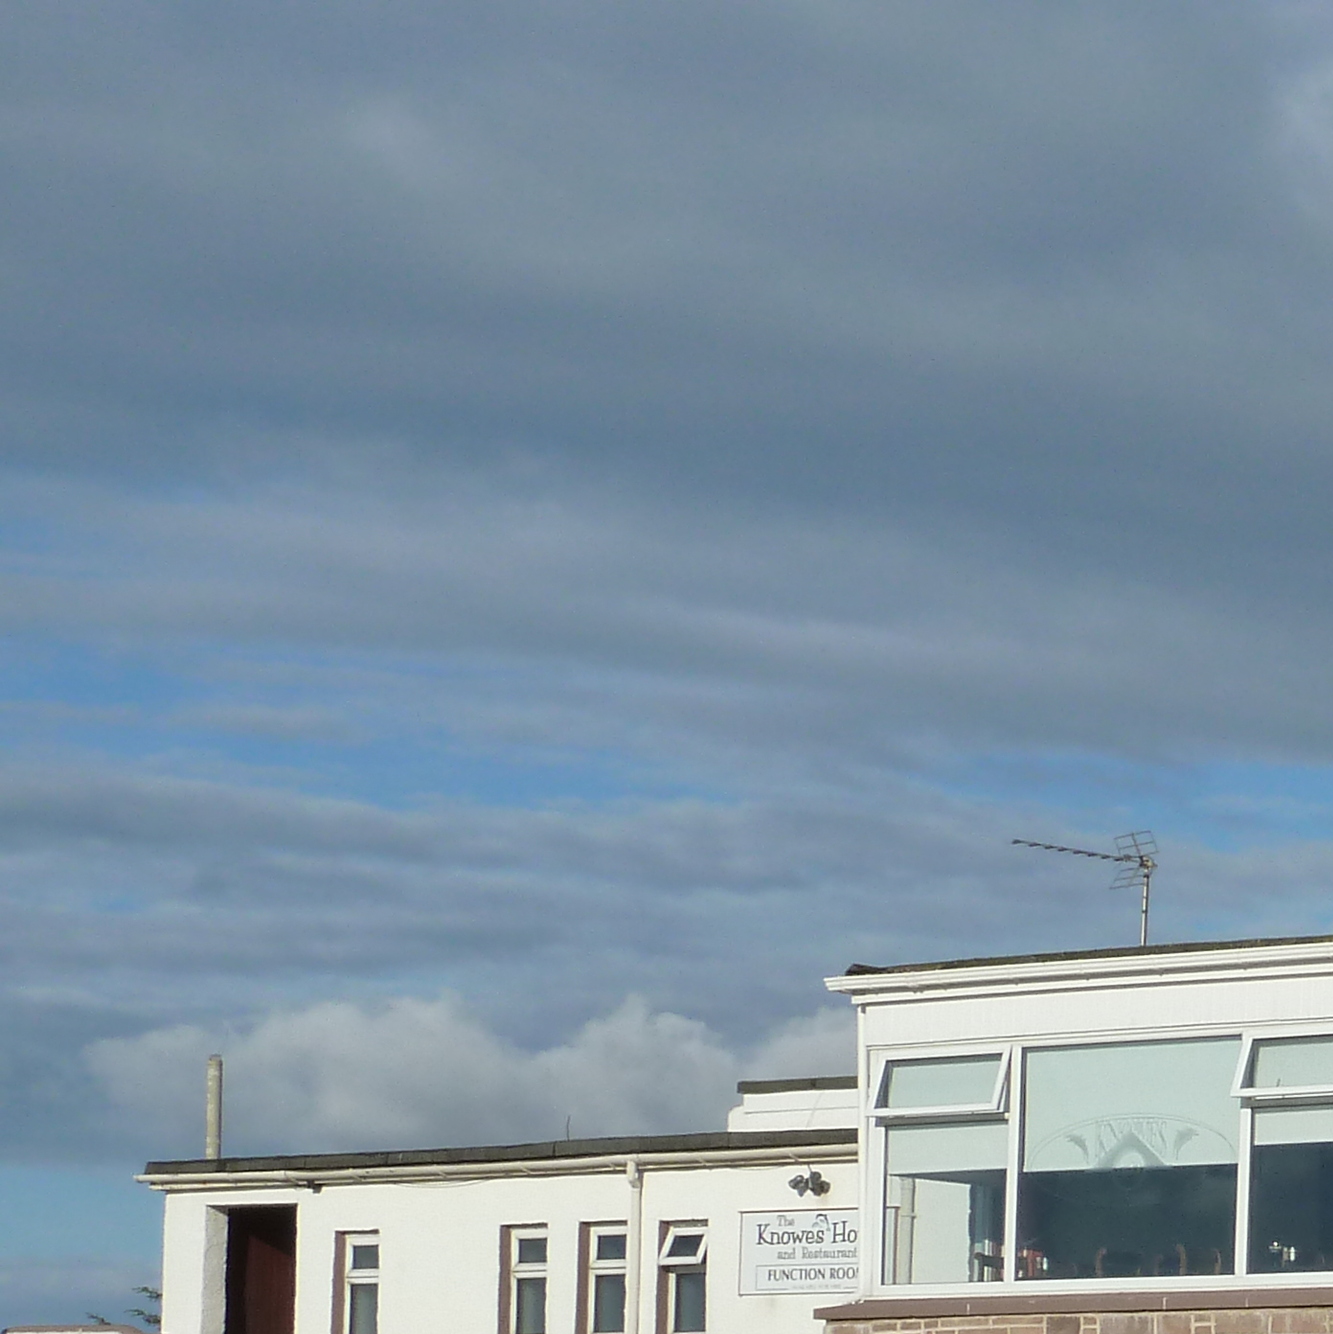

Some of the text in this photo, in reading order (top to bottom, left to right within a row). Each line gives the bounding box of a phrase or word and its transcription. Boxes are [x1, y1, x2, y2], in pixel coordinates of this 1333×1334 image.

[777, 1215, 795, 1227] The
[756, 1223, 825, 1245] Knowes
[777, 1246, 858, 1259] and Restaurant
[767, 1267, 859, 1282] FUNCTION ROO
